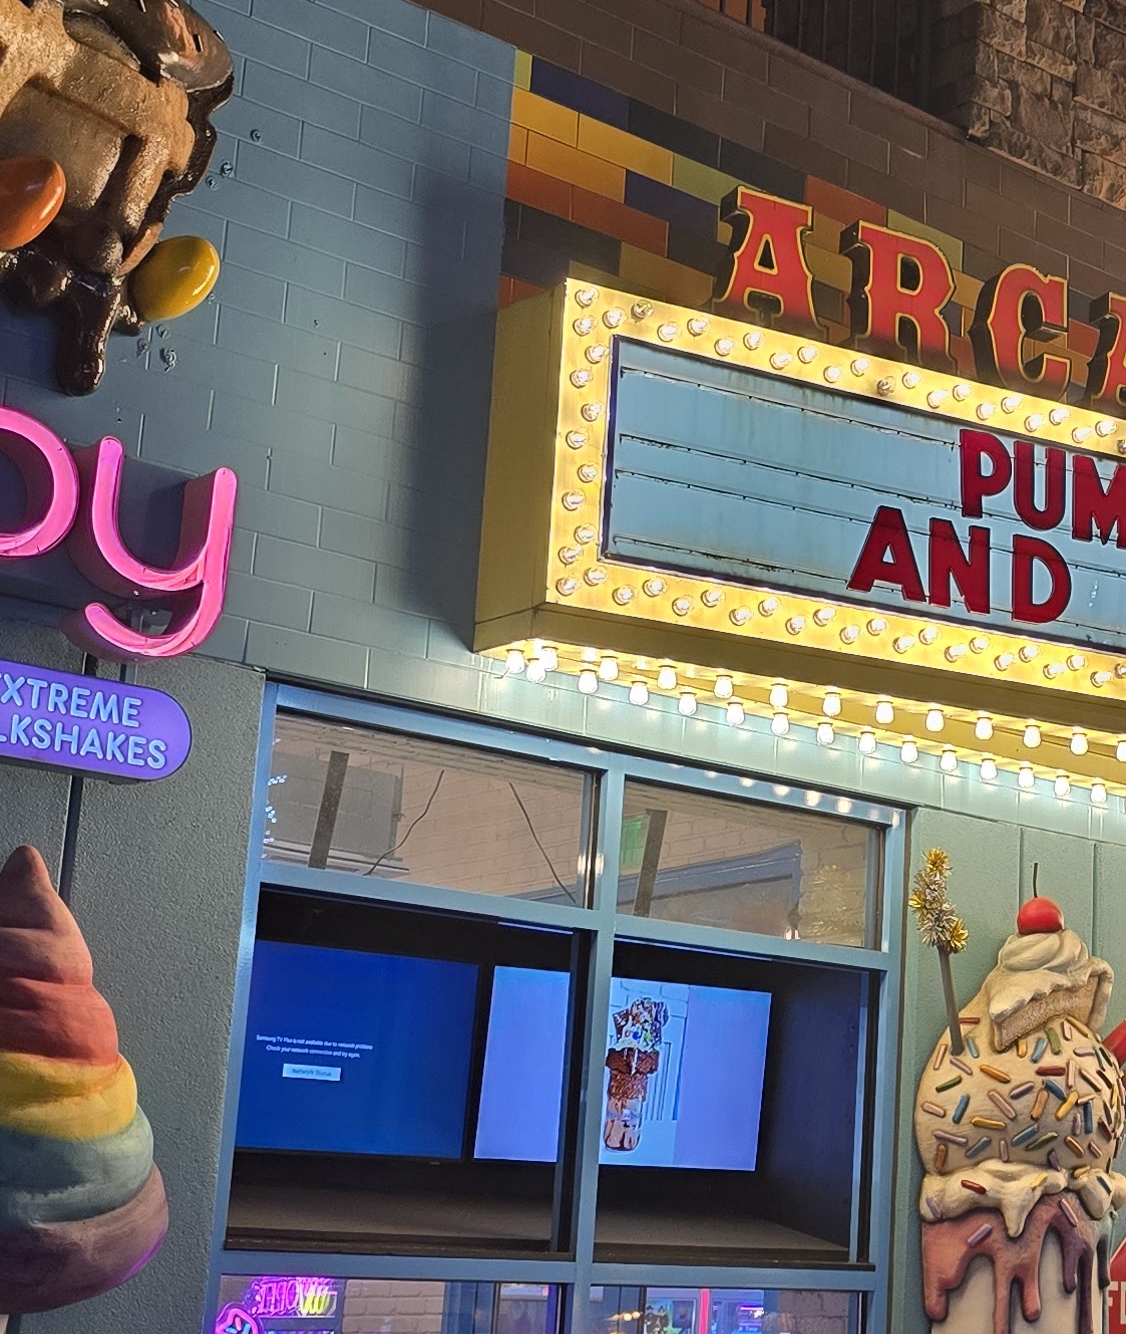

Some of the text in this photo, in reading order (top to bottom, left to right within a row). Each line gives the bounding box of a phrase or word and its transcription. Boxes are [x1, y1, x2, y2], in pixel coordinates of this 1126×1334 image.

[847, 505, 1073, 624] AND
[0, 672, 142, 728] XTREME
[0, 713, 168, 769] KSHAKES
